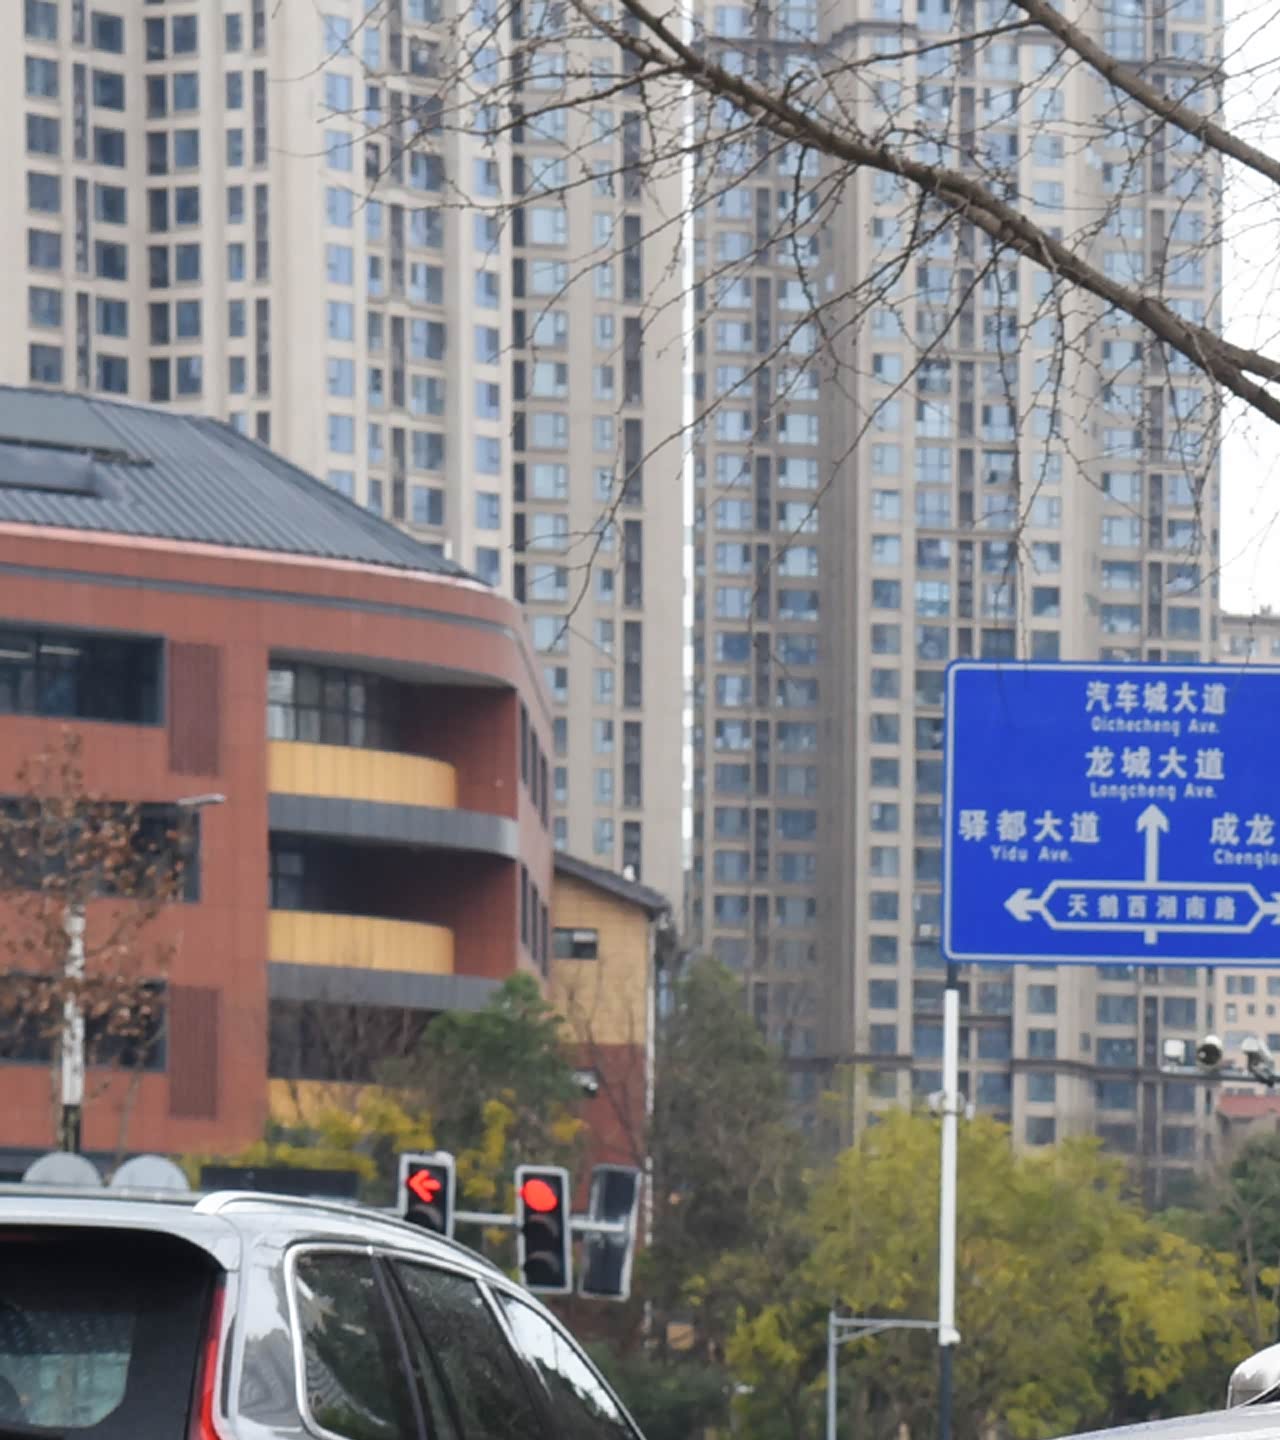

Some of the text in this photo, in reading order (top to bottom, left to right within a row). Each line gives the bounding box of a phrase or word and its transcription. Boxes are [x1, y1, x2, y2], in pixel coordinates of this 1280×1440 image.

[1086, 681, 1226, 715] 汽车城大道
[1091, 716, 1219, 736] Qichecheng Ave.
[1085, 747, 1225, 780] 龙城大道
[1090, 782, 1217, 801] Longcheng Ave.
[958, 809, 1100, 844] 驿都大道
[991, 846, 1072, 862] Yidu Ave.
[1067, 894, 1236, 920] 天鹅西湖南路
